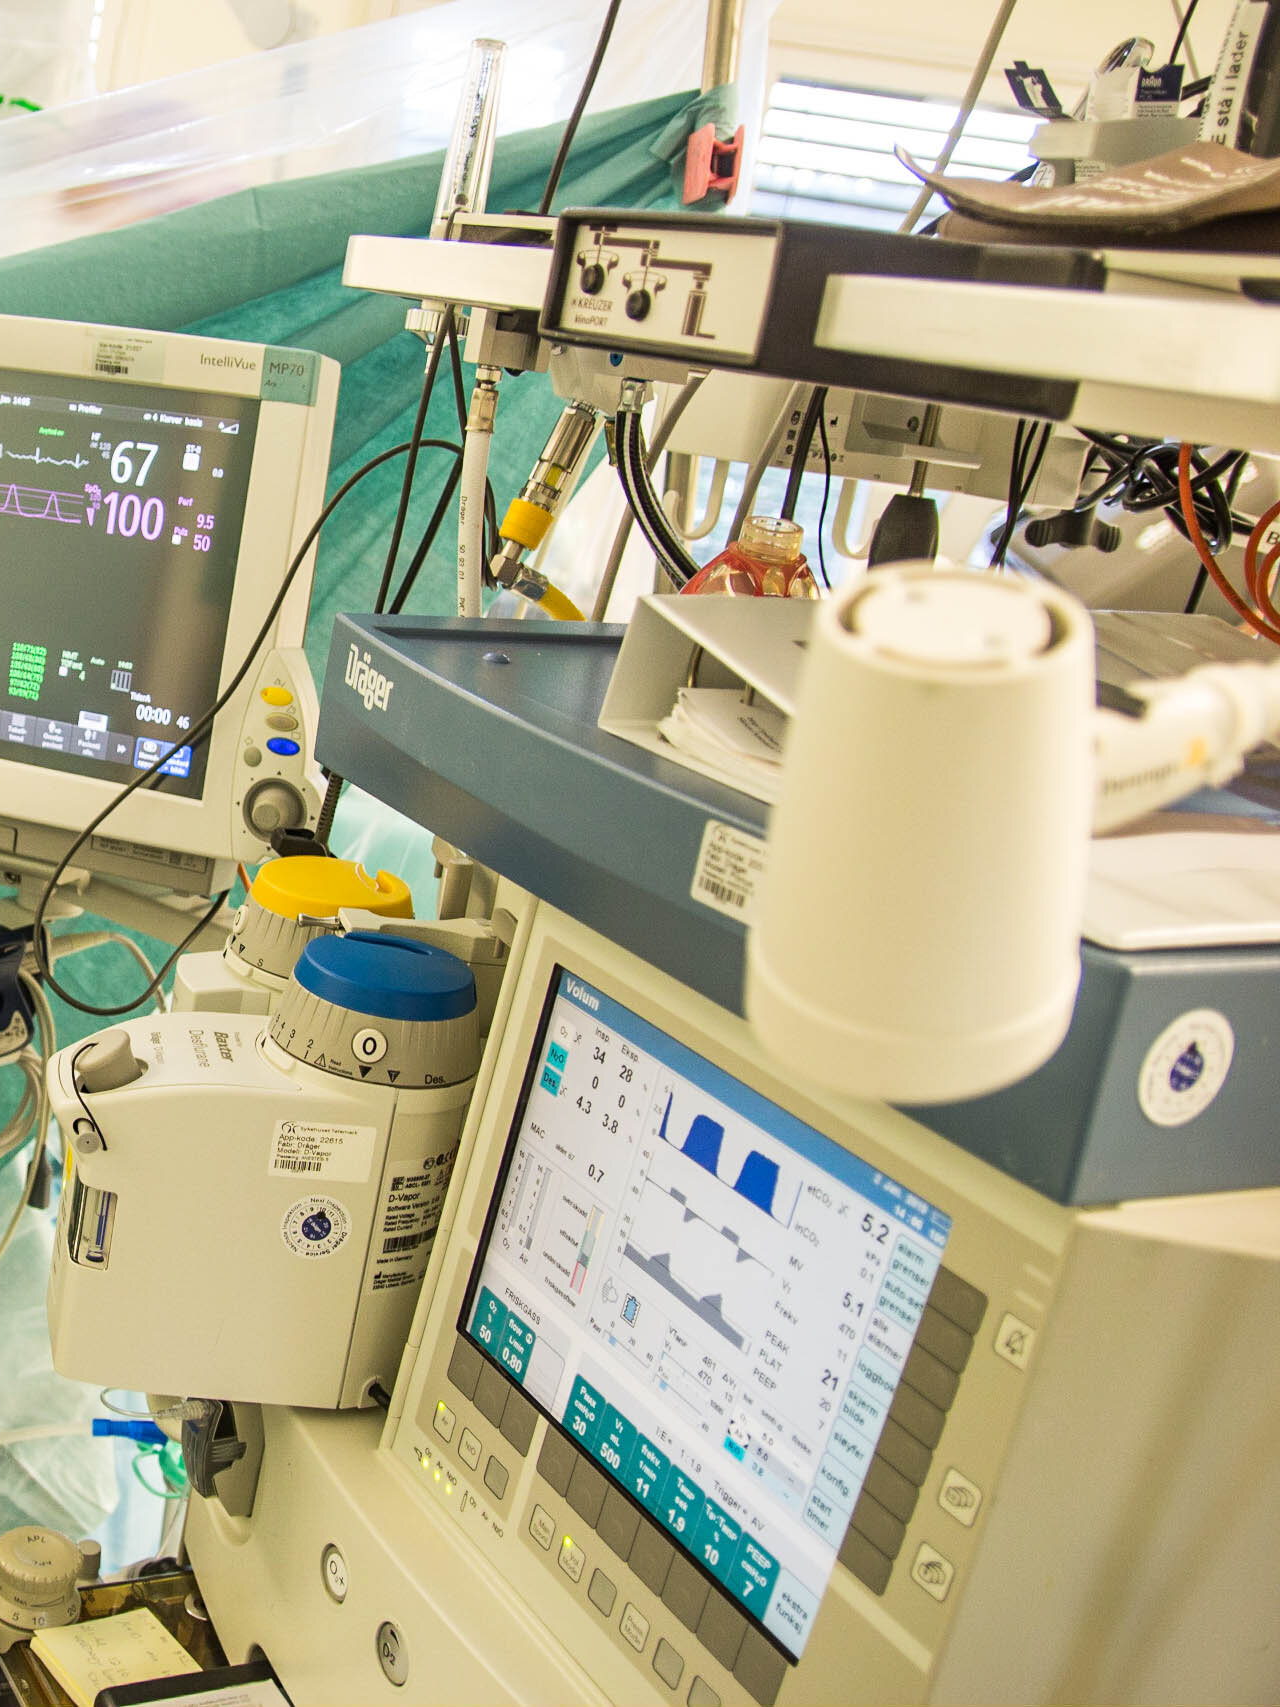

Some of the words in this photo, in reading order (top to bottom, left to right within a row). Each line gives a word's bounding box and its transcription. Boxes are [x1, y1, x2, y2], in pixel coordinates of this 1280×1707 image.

[1225, 31, 1249, 79] lader
[200, 353, 256, 371] IntelliVue
[270, 362, 304, 376] MP70
[110, 440, 159, 487] 67
[104, 491, 165, 541] 100
[196, 514, 215, 530] 9.5
[193, 534, 211, 552] 50
[79, 670, 85, 681] 4
[345, 643, 393, 711] Dräger
[136, 703, 171, 725] 00:00
[176, 715, 190, 730] 46
[565, 978, 600, 1011] Volum
[289, 1029, 296, 1039] 3
[307, 1039, 314, 1049] 2
[189, 1029, 210, 1068] Desflurane
[214, 1031, 234, 1062] Baxter
[592, 1046, 606, 1065] 34
[424, 1074, 446, 1085] Des.
[591, 1076, 599, 1089] 0
[619, 1065, 633, 1083] 28
[576, 1096, 592, 1114] 4.3
[618, 1094, 626, 1108] 0
[530, 1122, 546, 1139] MAC
[602, 1113, 618, 1134] 3.8
[588, 1164, 605, 1183] 0.7
[389, 1193, 420, 1202] D-Vapor
[860, 1213, 890, 1245] 5.2
[332, 1232, 347, 1250] Dräger
[789, 1256, 804, 1271] MV
[898, 1243, 925, 1266] alarm
[892, 1259, 930, 1288] grenser
[505, 1288, 541, 1325] FRISKGASS
[842, 1291, 865, 1318] 5.1
[878, 1295, 916, 1325] grenser
[480, 1325, 491, 1343] 50
[509, 1318, 523, 1336] flow
[838, 1323, 856, 1340] 470
[872, 1317, 888, 1334] alle
[765, 1329, 790, 1355] PEAK
[868, 1332, 904, 1362] alarmer
[502, 1347, 522, 1373] 0.80
[702, 1355, 717, 1371] 481
[760, 1348, 783, 1373] PLAT
[697, 1369, 713, 1386] 470
[753, 1367, 777, 1390] PEEP
[821, 1369, 839, 1391] 21
[848, 1389, 879, 1418] skjerm
[842, 1404, 865, 1426] bilde
[572, 1416, 586, 1436] 30
[600, 1442, 620, 1469] 500
[636, 1478, 650, 1498] 11
[821, 1466, 850, 1498] konfig
[712, 1479, 742, 1511] Trigger
[812, 1495, 832, 1516] start
[668, 1509, 686, 1533] 1.9
[806, 1507, 829, 1532] timer
[27, 1535, 46, 1543] APL
[704, 1544, 719, 1566] 10
[746, 1543, 772, 1570] PEEP
[743, 1580, 754, 1598] 7
[12, 1612, 19, 1621] 5
[782, 1592, 808, 1620] ekstra
[32, 1617, 45, 1626] 10
